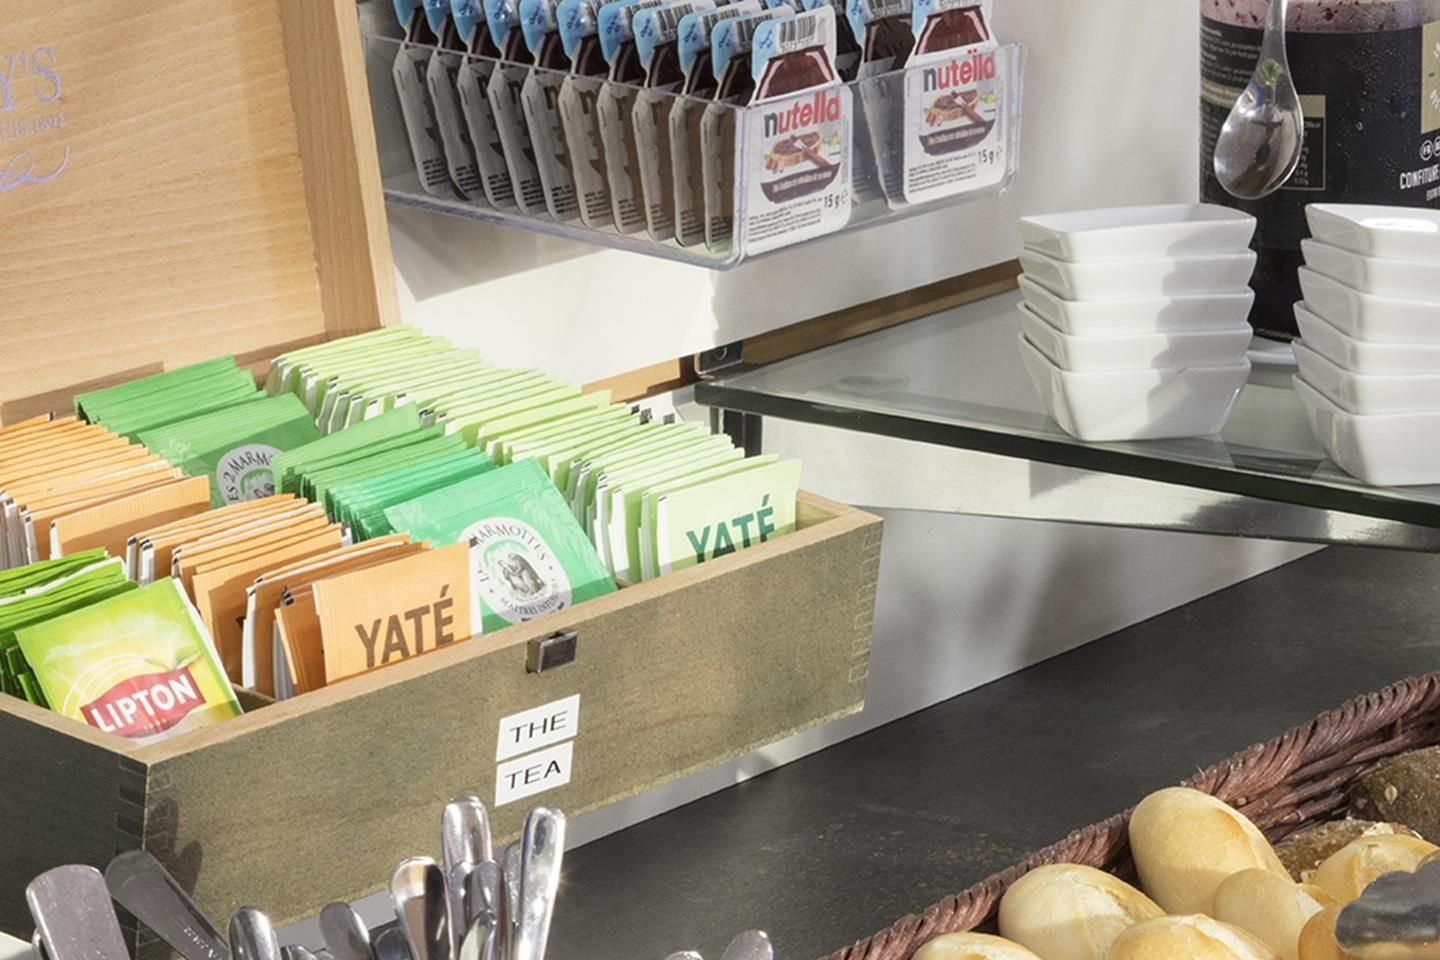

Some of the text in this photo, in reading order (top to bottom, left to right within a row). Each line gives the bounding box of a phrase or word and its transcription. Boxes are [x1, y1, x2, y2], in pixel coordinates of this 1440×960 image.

[922, 51, 996, 92] nutella
[763, 91, 841, 138] nutella
[824, 192, 834, 209] 15
[228, 450, 275, 476] MARM
[686, 493, 775, 565] YATÉ
[354, 583, 455, 669] YATÉ
[90, 673, 198, 734] LIPTON
[509, 710, 568, 744] THE
[504, 760, 562, 790] TEA
